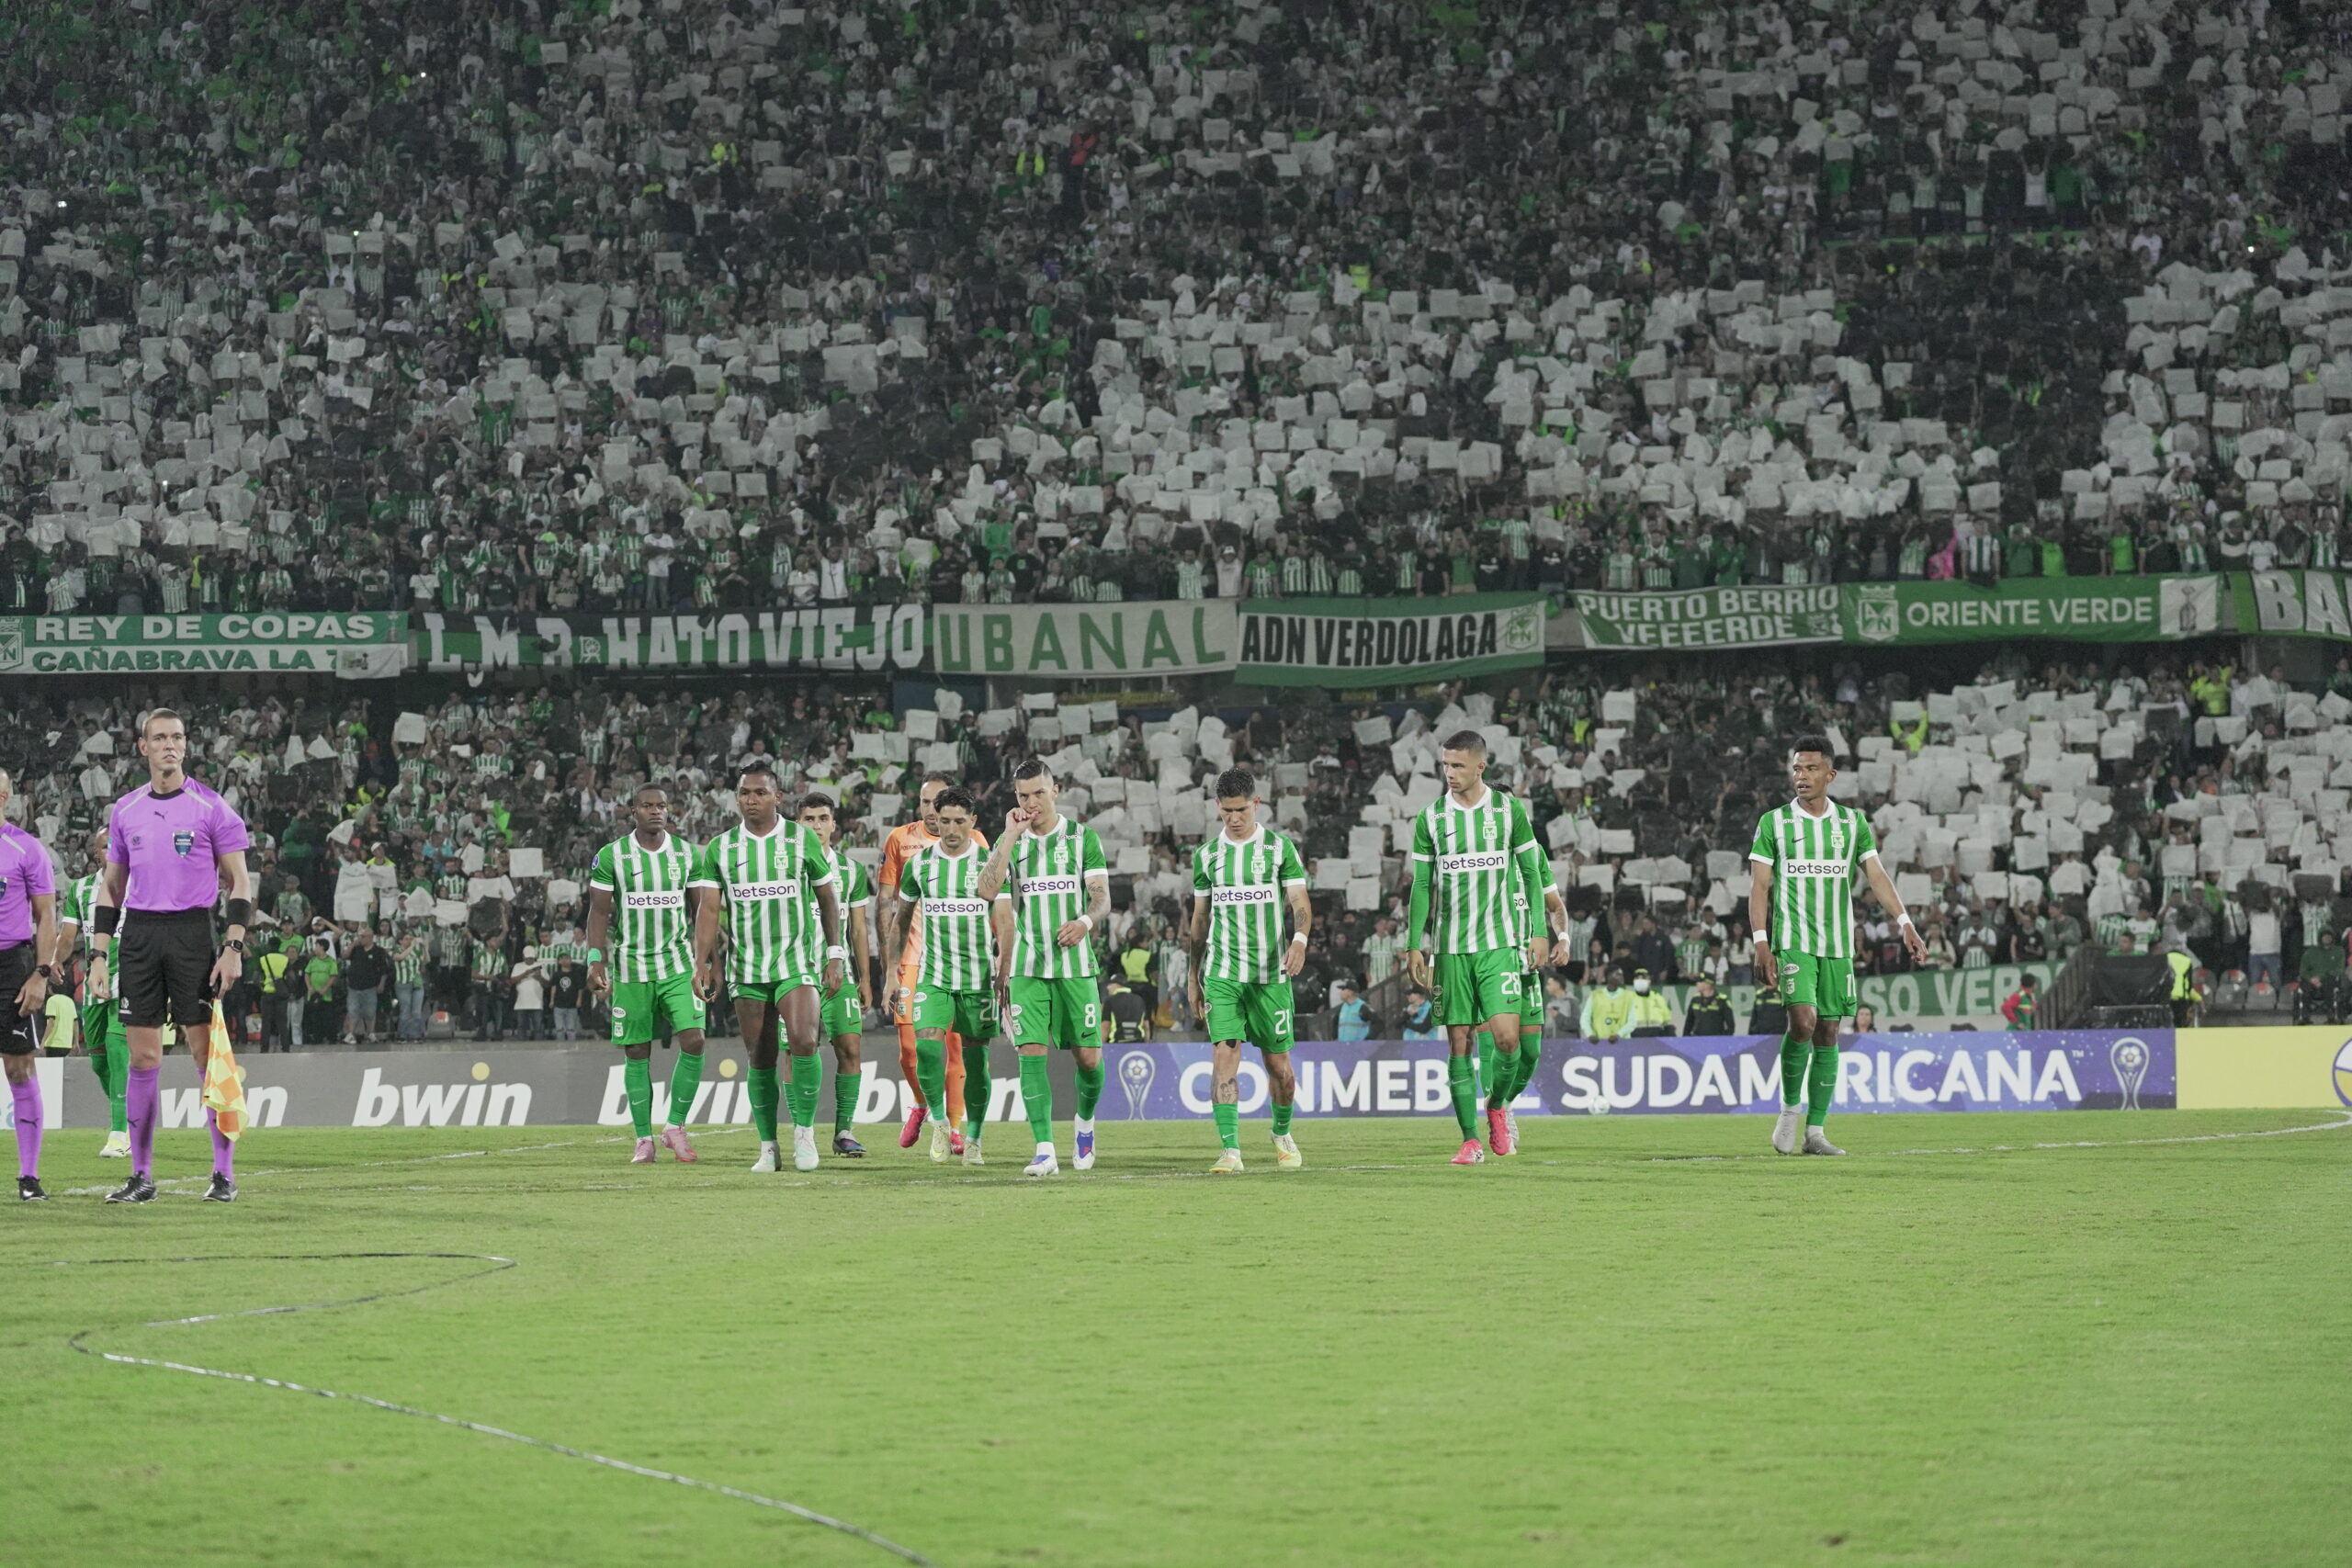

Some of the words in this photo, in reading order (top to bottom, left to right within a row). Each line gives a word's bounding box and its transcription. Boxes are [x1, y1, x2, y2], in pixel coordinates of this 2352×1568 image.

[1577, 594, 1707, 621] PUERTO
[1718, 586, 1837, 615] BERRIO
[1906, 598, 2040, 626] ORIENTE
[2048, 596, 2153, 624] VERDE
[2251, 570, 2352, 637] BA
[36, 615, 128, 641] REY
[142, 615, 202, 639] DE
[218, 615, 374, 639] COPAS
[938, 606, 1227, 671] UBANAL
[1241, 615, 1306, 664] ADN
[1313, 613, 1497, 666] VERDOLAGA
[32, 647, 257, 671] CAÑABRAVA
[269, 649, 317, 671] LA
[1442, 856, 1504, 870] betsson
[1788, 863, 1848, 874] betsson
[732, 885, 796, 898] betsson
[1021, 880, 1075, 893] etsson
[1213, 889, 1272, 902] betsson
[925, 901, 984, 913] betsson
[1500, 972, 1521, 996] 28
[1528, 985, 1543, 1008] 13
[1934, 963, 2066, 1017] VERD
[844, 998, 862, 1019] 19
[1084, 1003, 1096, 1028] 8
[1274, 1009, 1291, 1035] 21
[1179, 1058, 1541, 1114] CONMEB
[1561, 1049, 2082, 1110] SUDAMRICANA
[352, 1062, 532, 1127] bwin
